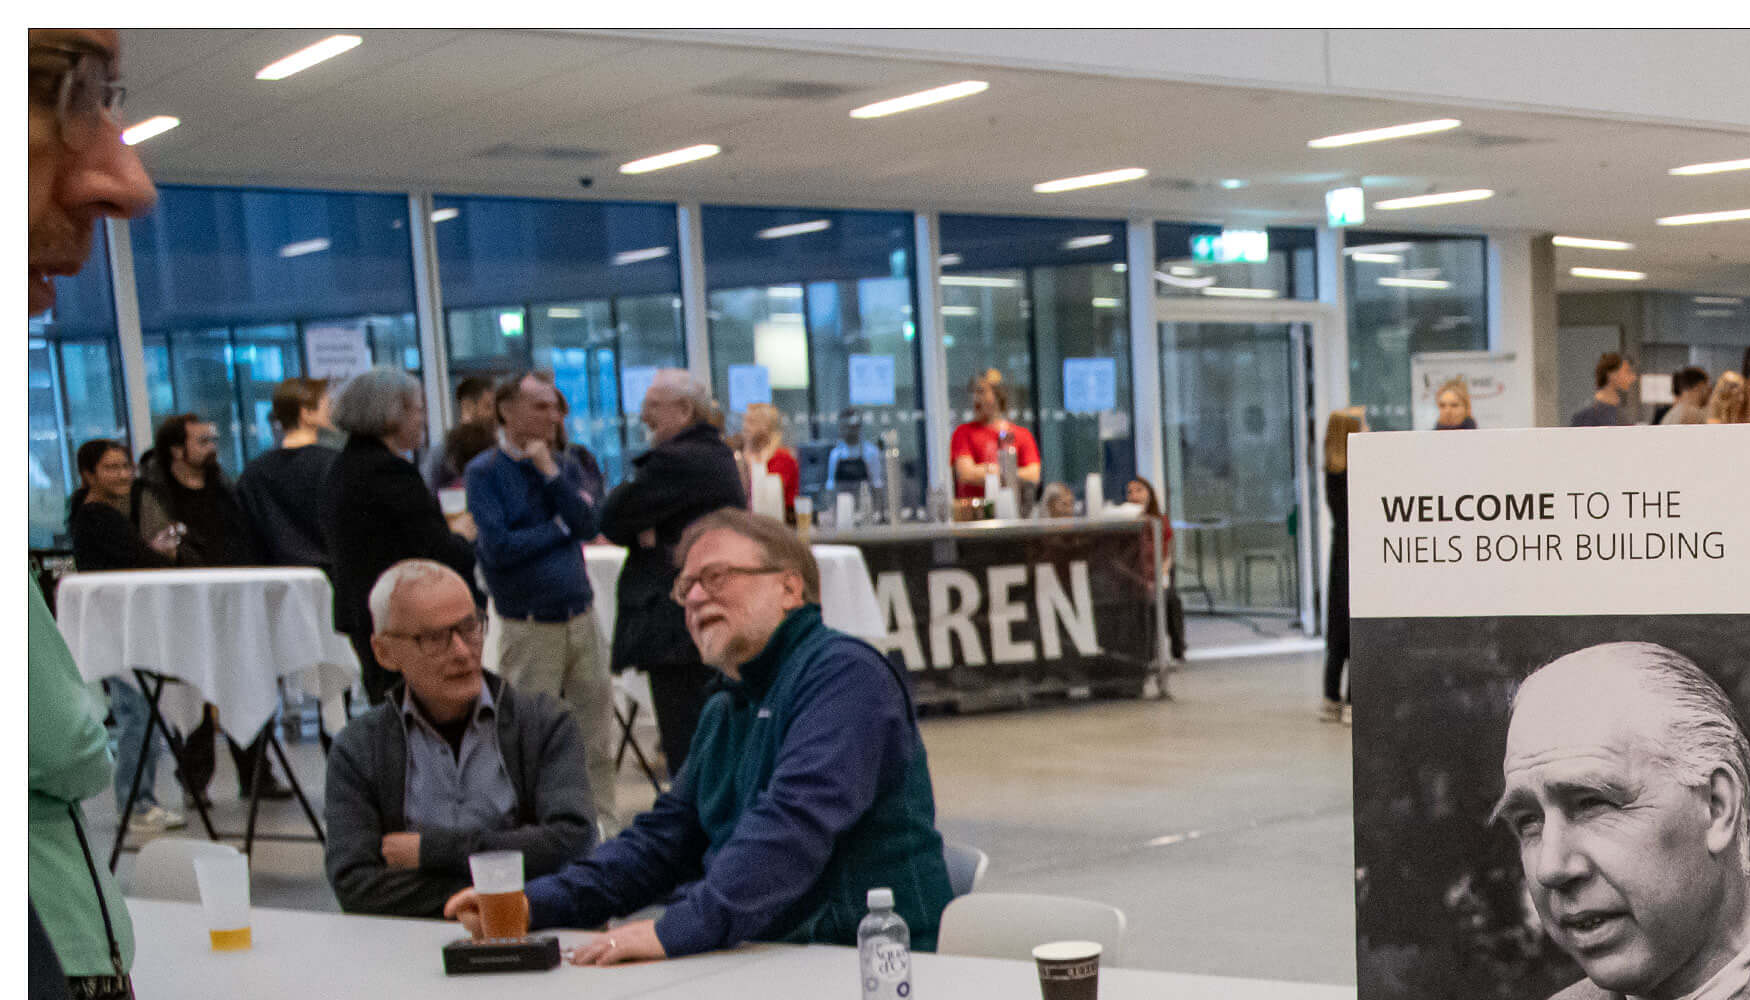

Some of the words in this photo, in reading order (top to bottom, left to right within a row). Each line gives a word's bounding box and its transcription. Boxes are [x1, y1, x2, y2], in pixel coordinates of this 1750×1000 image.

[1380, 493, 1555, 523] WELCOME
[1566, 491, 1610, 520] TO
[1621, 490, 1682, 519] THE
[1383, 535, 1463, 564] NIELS
[1476, 533, 1563, 562] BOHR
[1576, 531, 1726, 561] BUILDING
